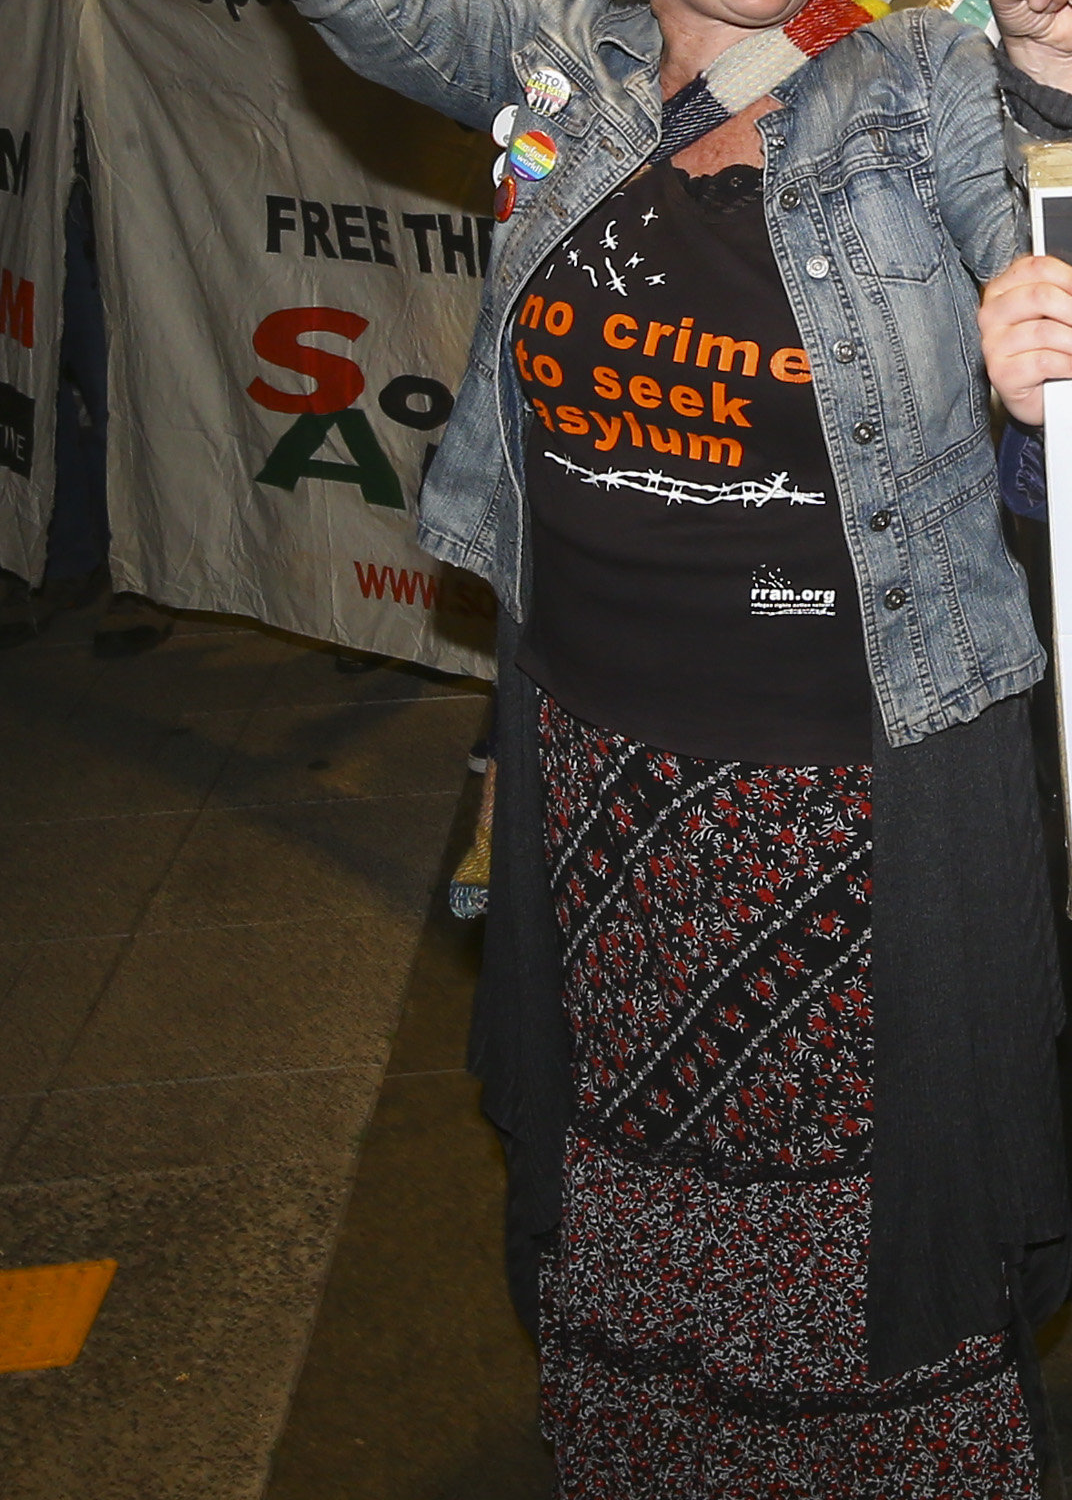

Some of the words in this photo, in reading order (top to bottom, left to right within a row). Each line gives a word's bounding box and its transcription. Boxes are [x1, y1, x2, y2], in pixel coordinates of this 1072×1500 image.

[265, 194, 398, 268] FREE
[519, 293, 574, 336] no
[603, 313, 812, 384] crime
[515, 339, 563, 388] to
[592, 366, 752, 428] seek
[532, 398, 744, 468] asylum
[751, 588, 836, 604] rran.org
